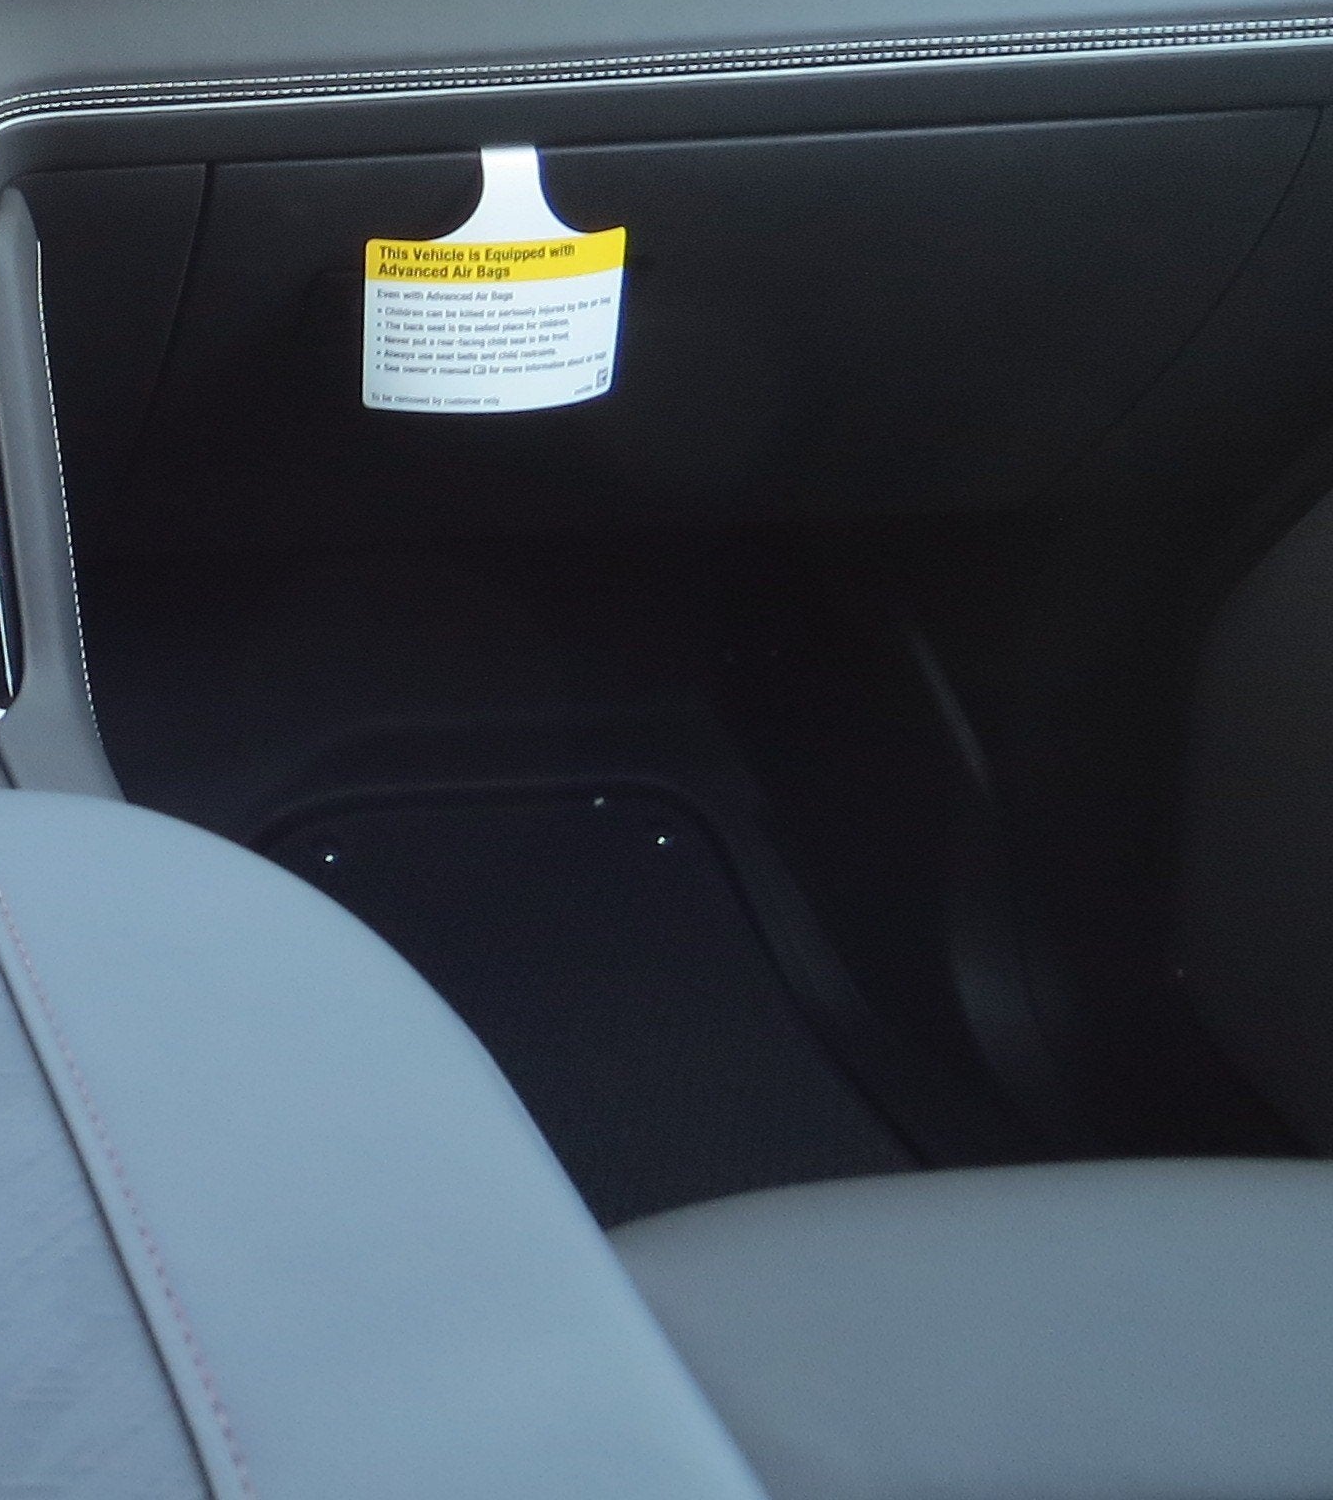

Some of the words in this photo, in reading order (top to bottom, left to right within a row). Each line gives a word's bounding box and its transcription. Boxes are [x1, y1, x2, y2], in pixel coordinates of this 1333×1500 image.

[380, 245, 408, 260] This
[413, 247, 464, 261] Vehicle
[485, 246, 545, 263] Equipped
[550, 244, 575, 258] with
[379, 262, 448, 278] Advanced
[453, 265, 473, 278] Air
[477, 265, 510, 280] Bags
